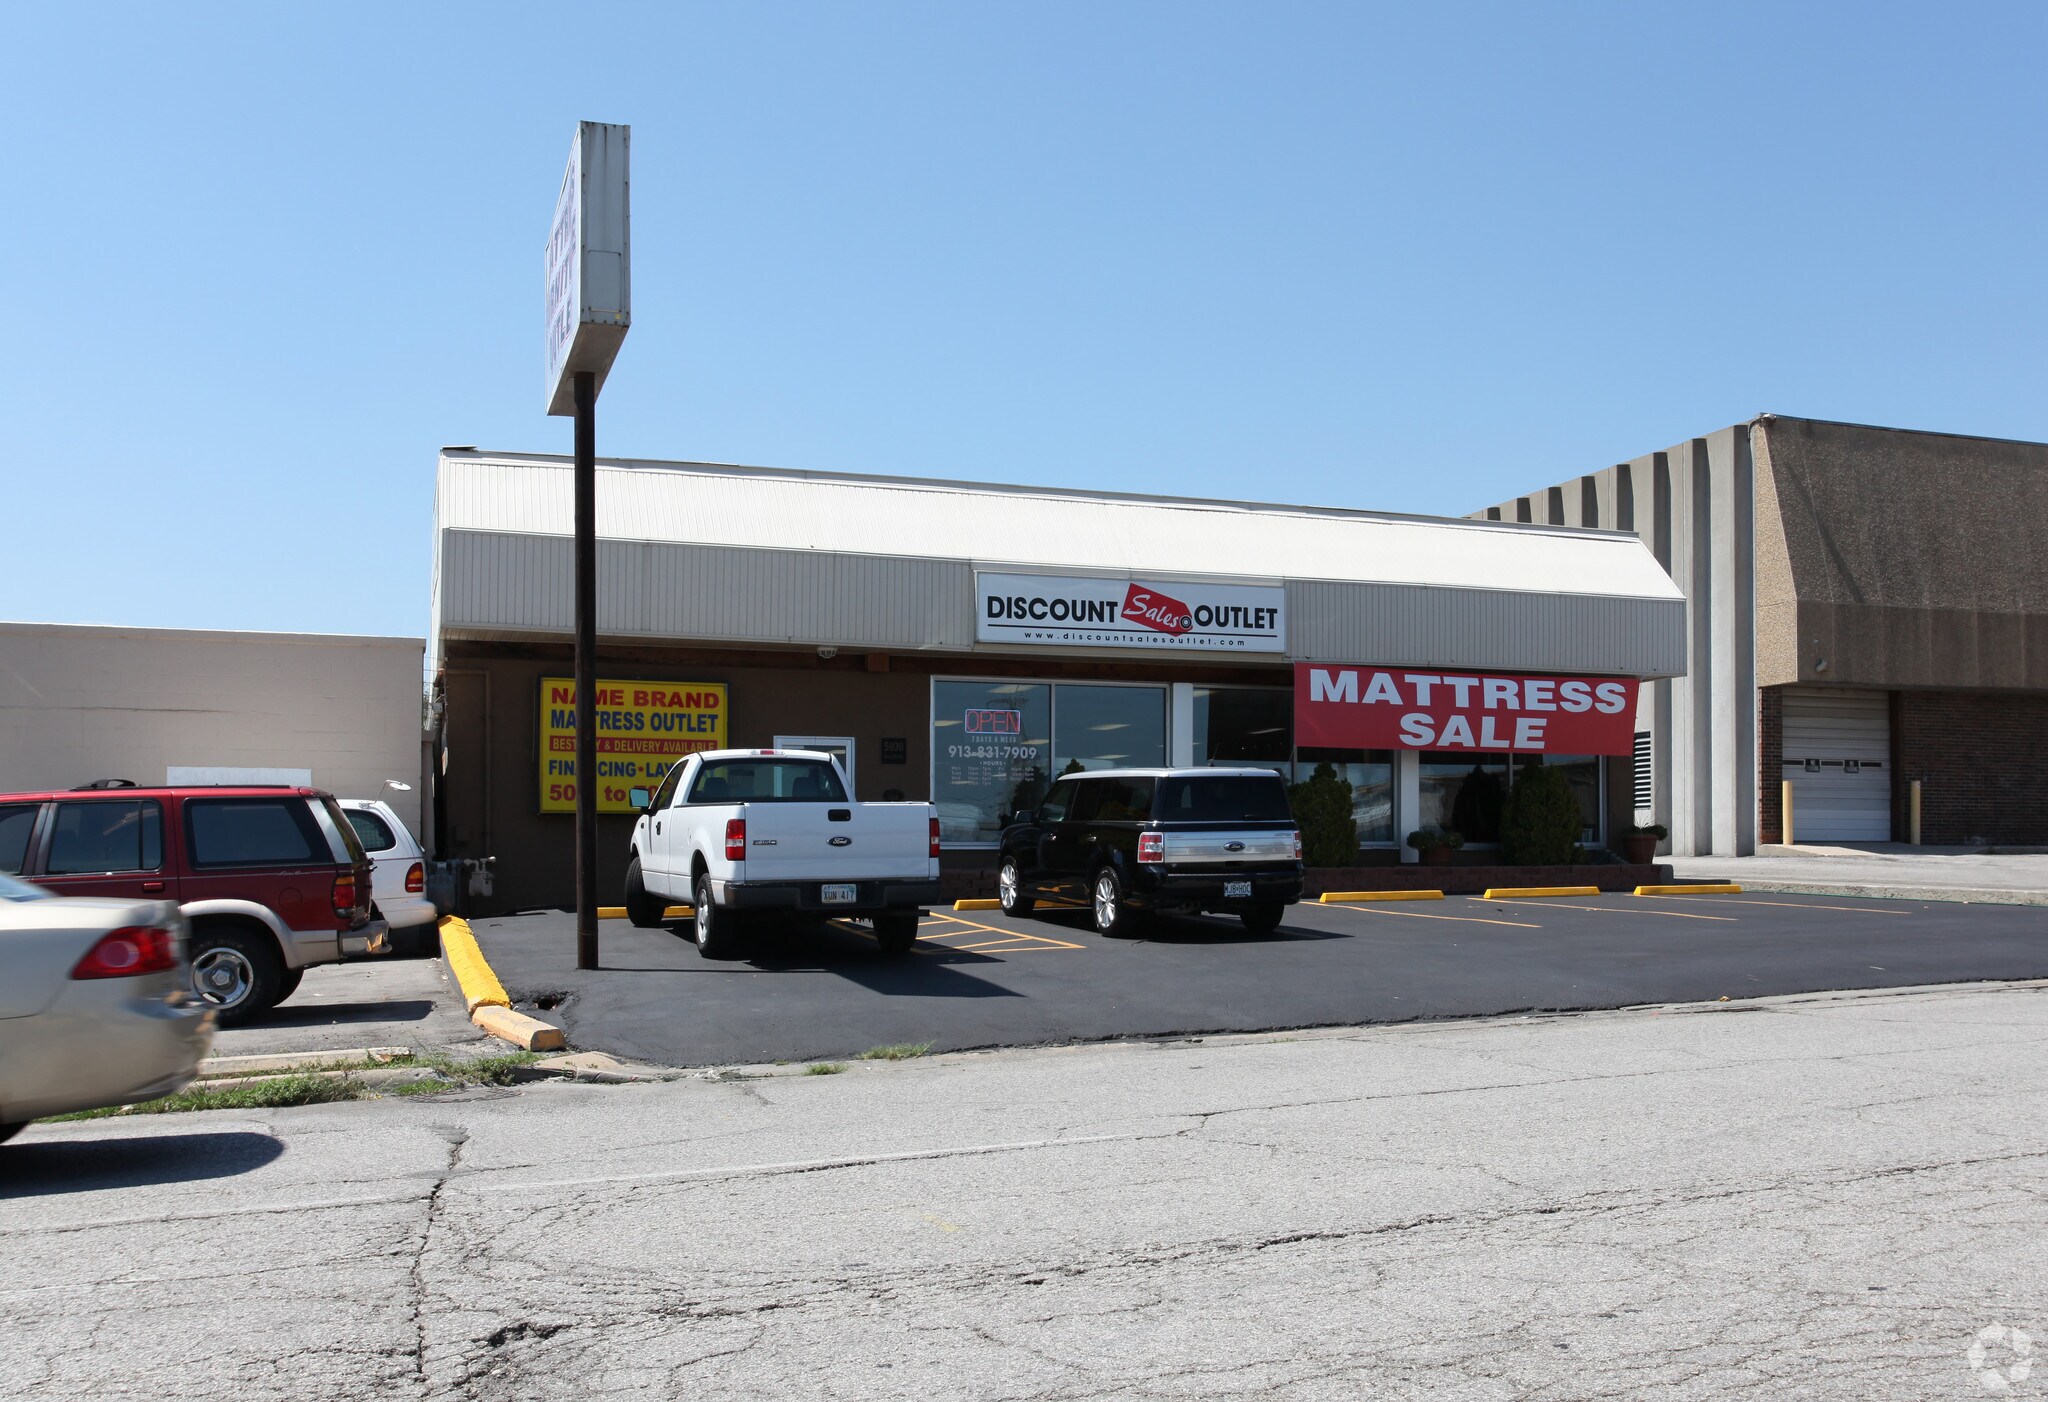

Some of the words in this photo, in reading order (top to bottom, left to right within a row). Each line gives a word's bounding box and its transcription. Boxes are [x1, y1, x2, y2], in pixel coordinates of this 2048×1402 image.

[987, 594, 1118, 623] DISCOUNT
[1123, 594, 1179, 628] Sales
[1195, 604, 1278, 629] OUTLET
[1025, 632, 1245, 645] www.discountsalesoutlet.com
[634, 690, 719, 708] BRAND
[1310, 669, 1626, 714] MATTRESS
[551, 710, 644, 731] MARESS
[651, 712, 718, 732] OUTLET
[967, 711, 1018, 732] OPEN
[1399, 713, 1548, 749] SALE
[614, 740, 661, 751] DELIVERY
[663, 743, 714, 753] AVAILABLE
[949, 745, 1037, 758] 913-831-7909
[549, 760, 636, 777] FINCING
[604, 785, 626, 801] to
